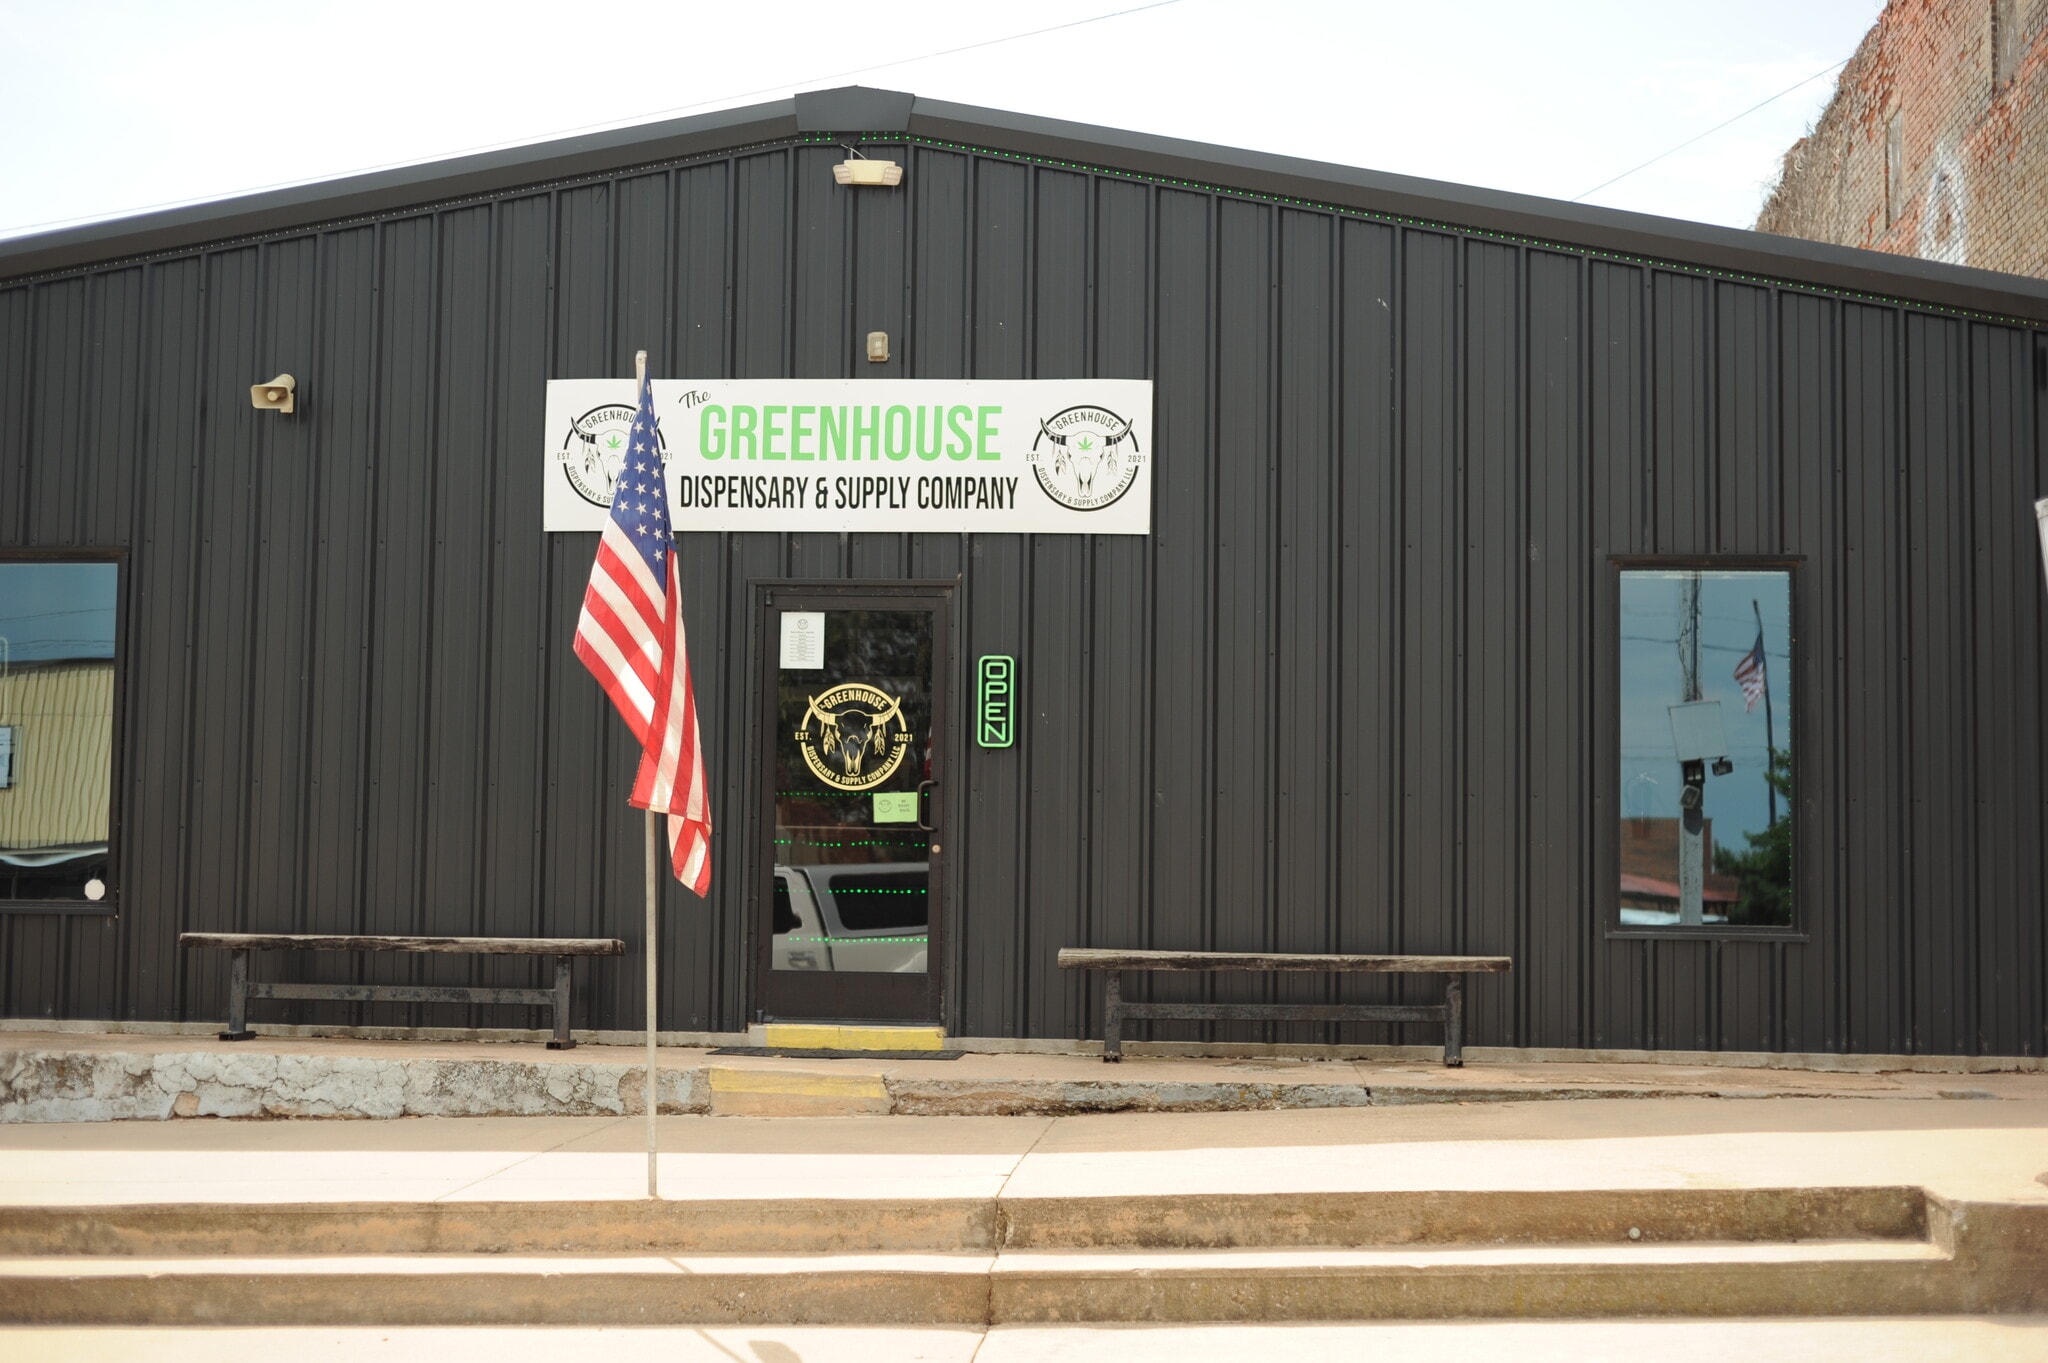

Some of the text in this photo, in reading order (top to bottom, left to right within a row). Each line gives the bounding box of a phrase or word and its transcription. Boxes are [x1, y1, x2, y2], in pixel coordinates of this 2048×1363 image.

[678, 390, 711, 409] The
[585, 410, 636, 429] GREENHOU
[1055, 411, 1119, 431] GREENHOUSE
[699, 404, 1003, 462] GREENHOUSE
[660, 452, 673, 460] 021
[1128, 455, 1146, 463] 2021
[569, 466, 596, 499] DISPENSARY
[680, 475, 1018, 510] DISPENSARY & SUPPLY COMPANY
[1038, 467, 1066, 501] DISPENSARY
[1073, 498, 1098, 506] SUPPLY
[1100, 479, 1127, 503] COMPANY
[1123, 467, 1133, 480] LLC
[824, 690, 887, 710] GREENHOUSE
[984, 662, 1007, 742] OPEN
[794, 732, 913, 742] EST. 2021
[807, 745, 835, 779] DISPENSARY
[841, 776, 866, 785] SUPPLY
[867, 758, 895, 782] COMPANY
[891, 746, 901, 760] LLC
